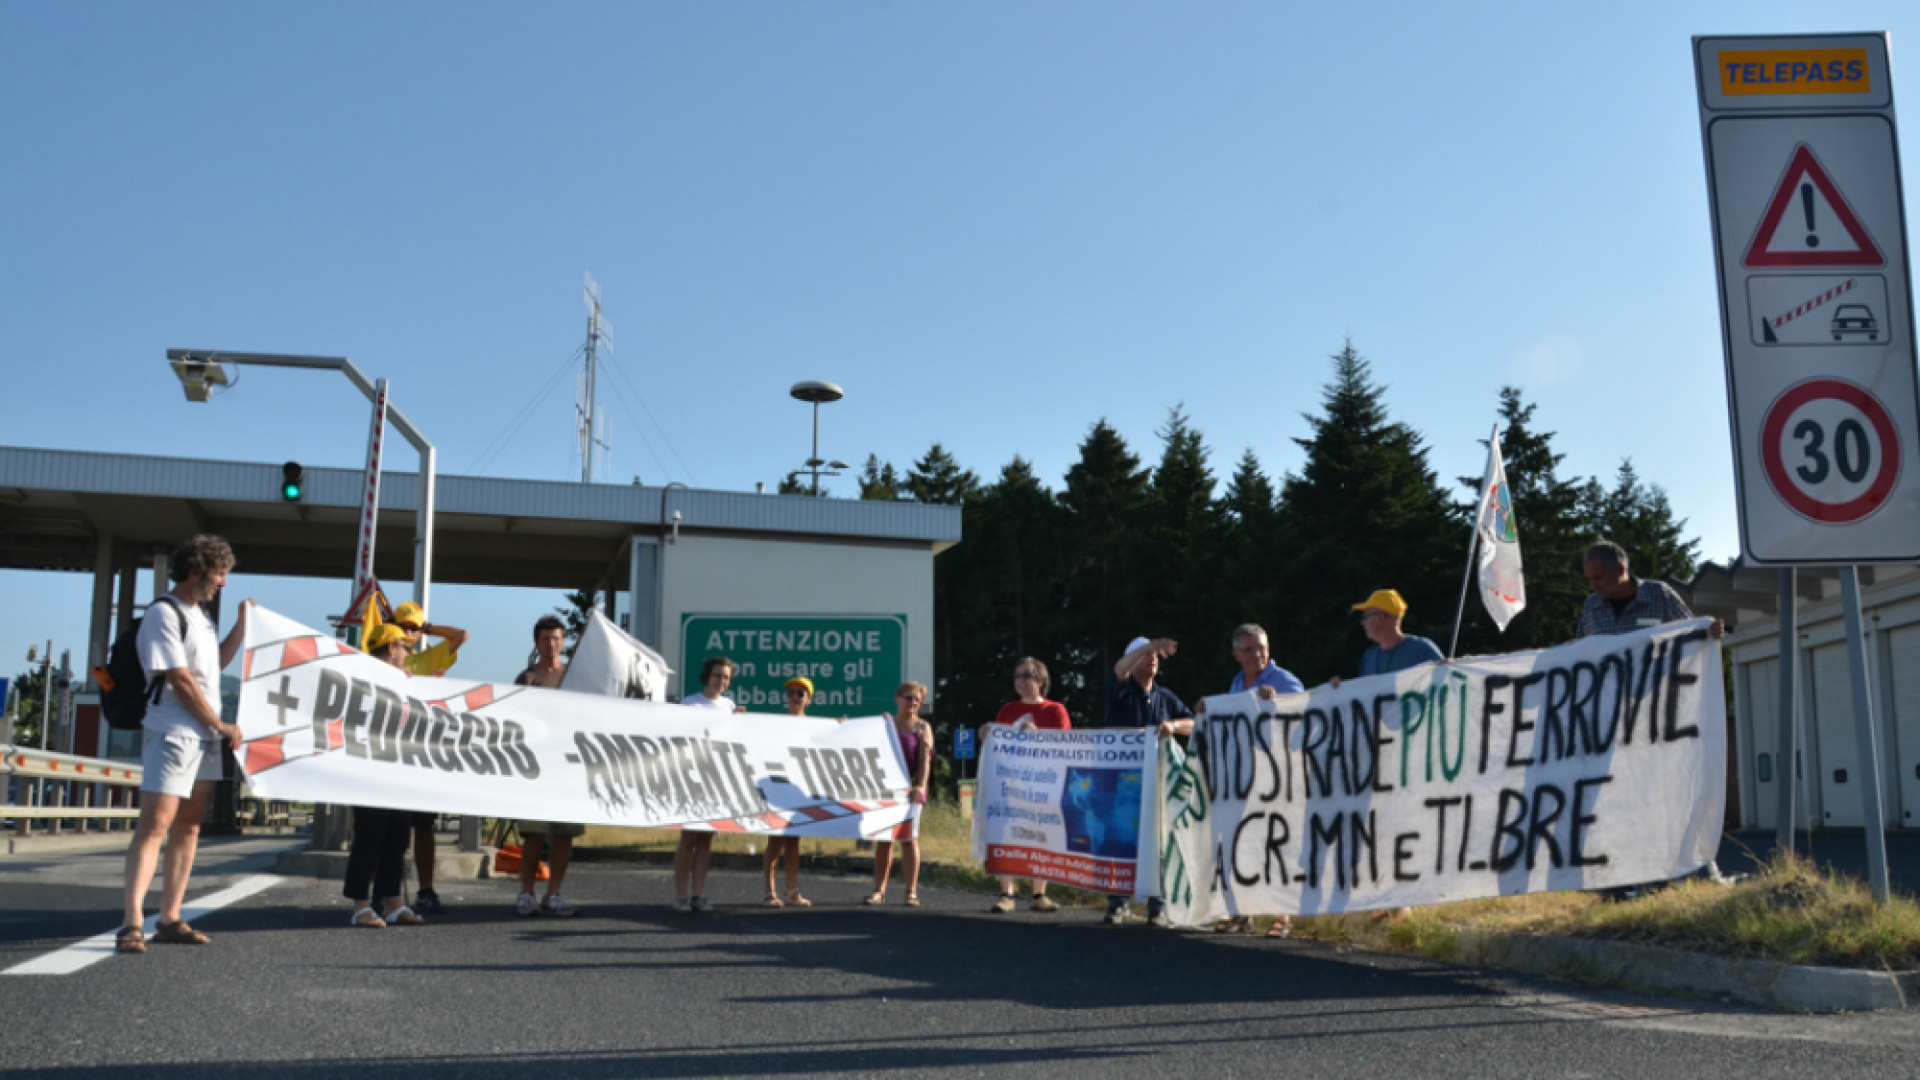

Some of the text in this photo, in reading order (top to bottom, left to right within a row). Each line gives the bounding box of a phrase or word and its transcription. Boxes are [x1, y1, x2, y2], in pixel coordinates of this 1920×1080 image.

[1726, 60, 1864, 84] TELEPASS
[1793, 417, 1871, 484] 30
[706, 630, 882, 651] ATTENZIONE
[732, 657, 873, 681] on usare gli
[1400, 671, 1467, 787] PIÙ
[1478, 628, 1707, 775] FERROVIE
[312, 667, 541, 780] PEDAGGIO
[788, 747, 894, 801] TIBRE
[959, 730, 970, 744] P
[992, 726, 1117, 746] COORDINAMENTO
[993, 847, 1027, 861] Dalle
[1394, 832, 1421, 881] E
